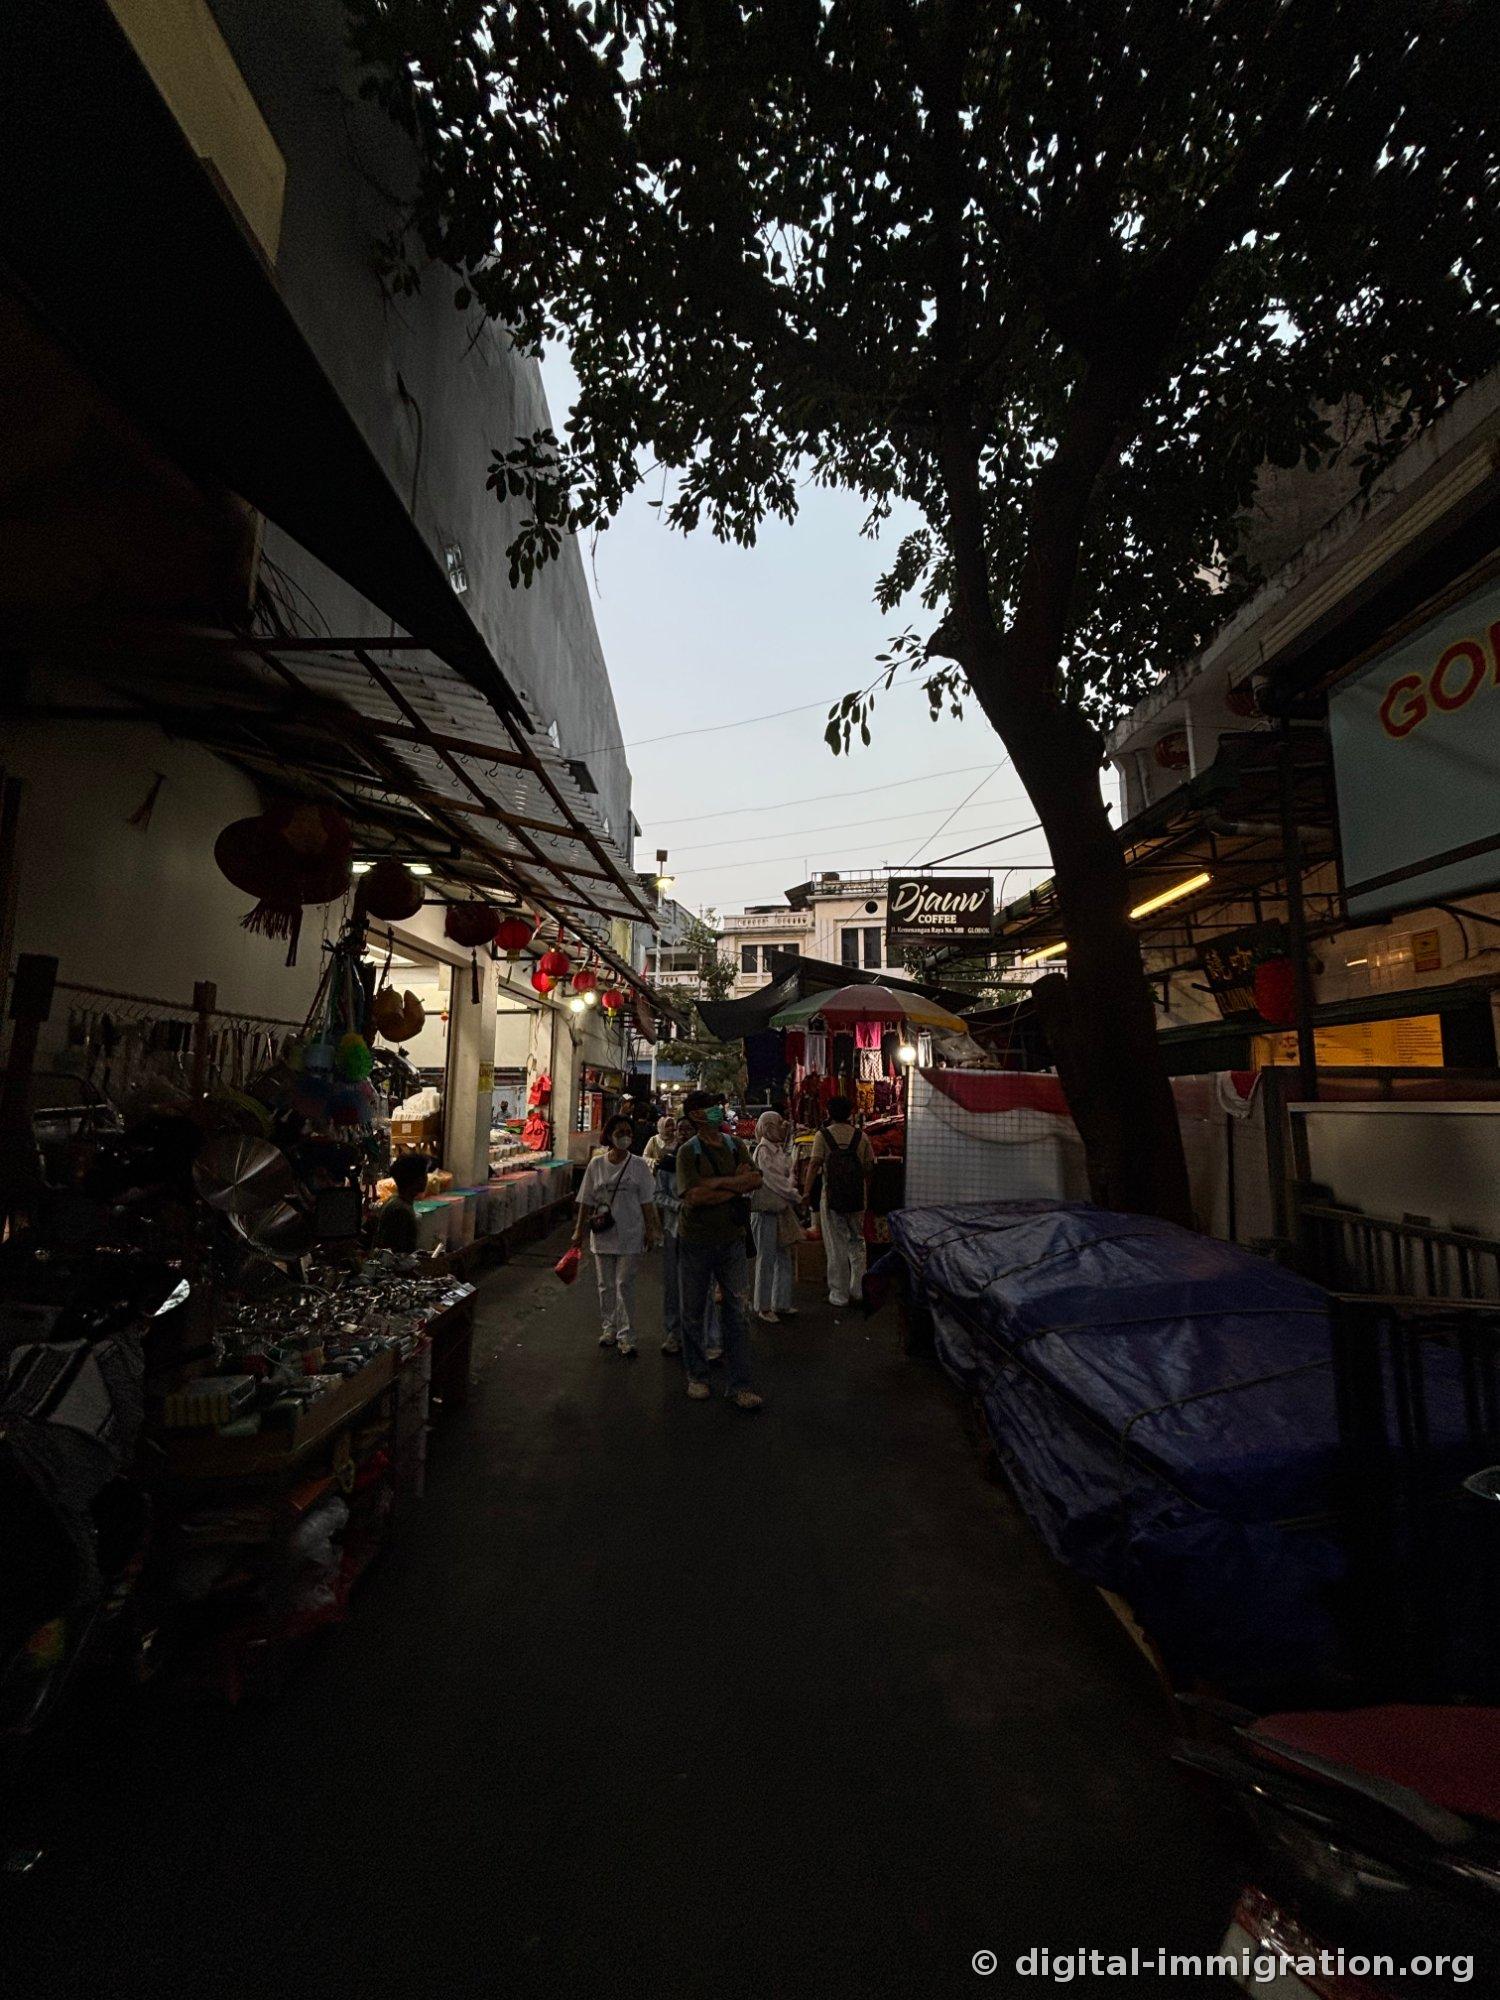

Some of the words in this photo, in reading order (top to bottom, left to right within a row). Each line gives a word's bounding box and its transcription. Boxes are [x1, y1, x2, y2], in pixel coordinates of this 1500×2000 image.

[1380, 619, 1500, 738] GO
[891, 882, 986, 922] Djauw
[918, 914, 957, 924] COFFEE
[931, 926, 944, 935] Raya
[967, 926, 990, 934] GLODOK
